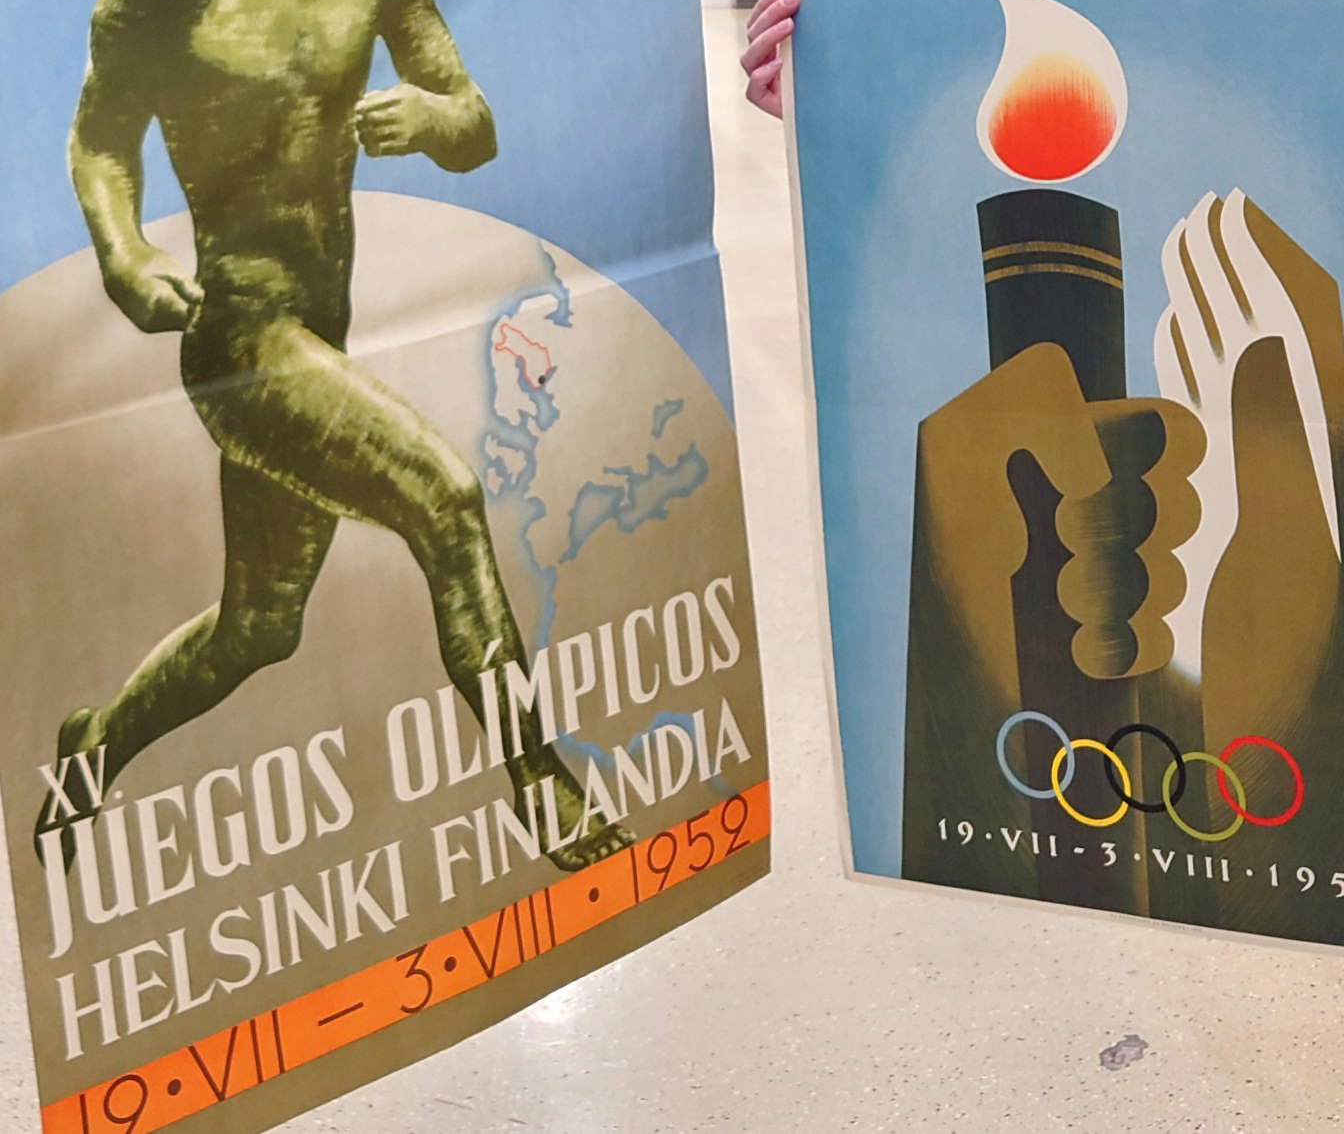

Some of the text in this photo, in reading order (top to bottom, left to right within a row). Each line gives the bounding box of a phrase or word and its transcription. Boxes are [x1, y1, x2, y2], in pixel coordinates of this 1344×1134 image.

[38, 575, 741, 959] JUEGOS OLÍMPICOS
[56, 698, 752, 1061] HELSINKI FINLANDIA
[629, 794, 751, 904] 1952
